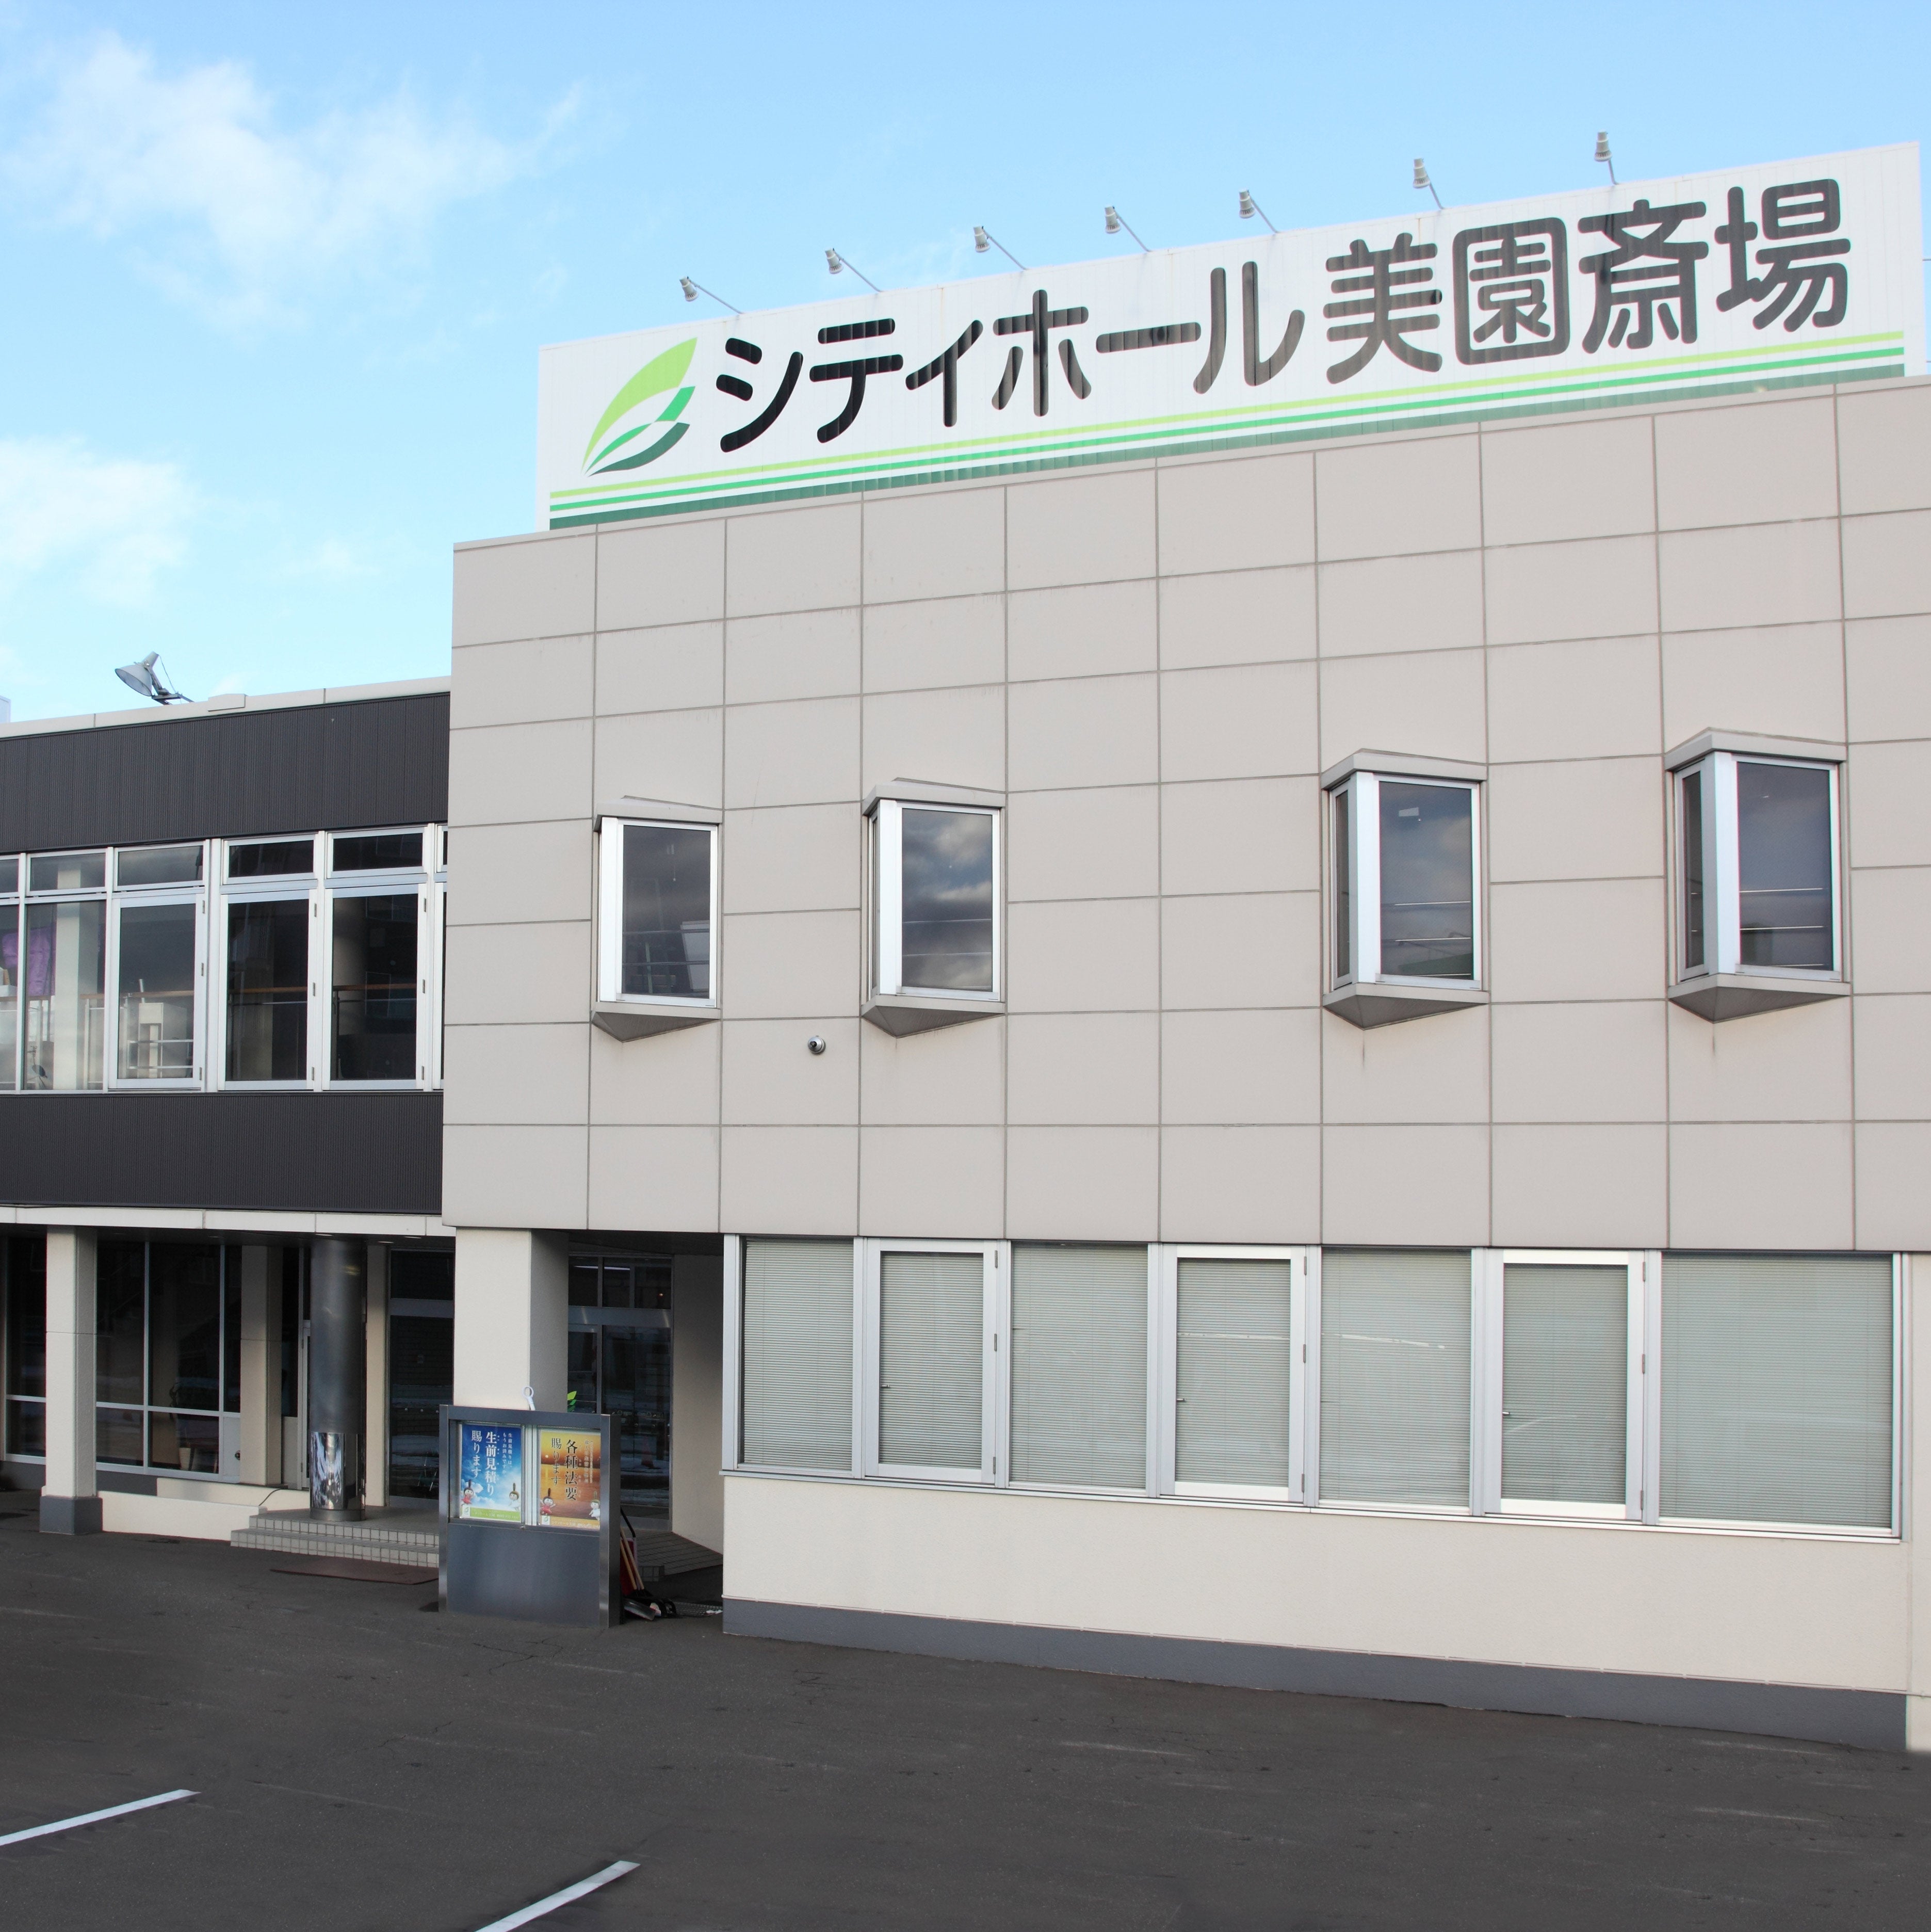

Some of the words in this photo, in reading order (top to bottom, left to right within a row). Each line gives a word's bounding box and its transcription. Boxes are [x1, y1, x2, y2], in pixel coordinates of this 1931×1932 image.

[471, 1430, 482, 1478] 賜ります
[485, 1431, 497, 1496] 生前見積り
[551, 1438, 562, 1486] 賜ります
[565, 1439, 578, 1501] 各種法要
